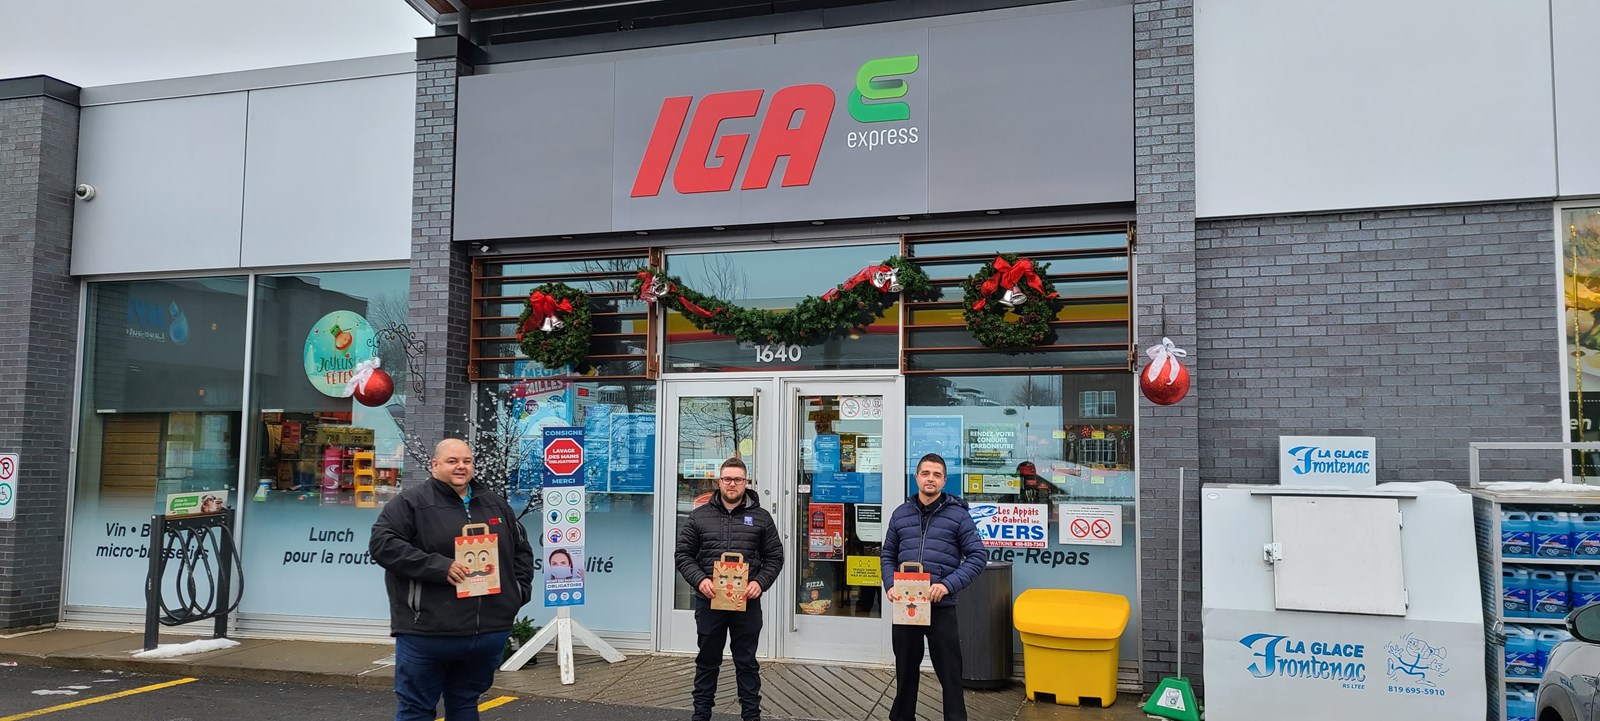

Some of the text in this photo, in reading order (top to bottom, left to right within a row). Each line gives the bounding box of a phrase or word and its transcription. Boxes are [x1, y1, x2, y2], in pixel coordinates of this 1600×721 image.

[631, 84, 836, 198] IGA
[847, 126, 919, 151] express
[754, 344, 802, 363] 1640
[1287, 445, 1370, 475] Frontenac
[1318, 450, 1369, 459] LA GLACE
[992, 516, 1030, 524] St-Gabriel
[998, 506, 1039, 518] Les Appâts
[105, 522, 127, 537] Vin
[309, 527, 354, 542] Lunch
[986, 524, 1044, 541] VERS
[96, 543, 210, 560] micro-bsseries
[283, 550, 318, 565] pour
[320, 549, 334, 564] la
[1239, 633, 1366, 682] Frontenac
[1285, 640, 1364, 658] LA GLACE
[1388, 685, 1445, 696] 819 695-5910
